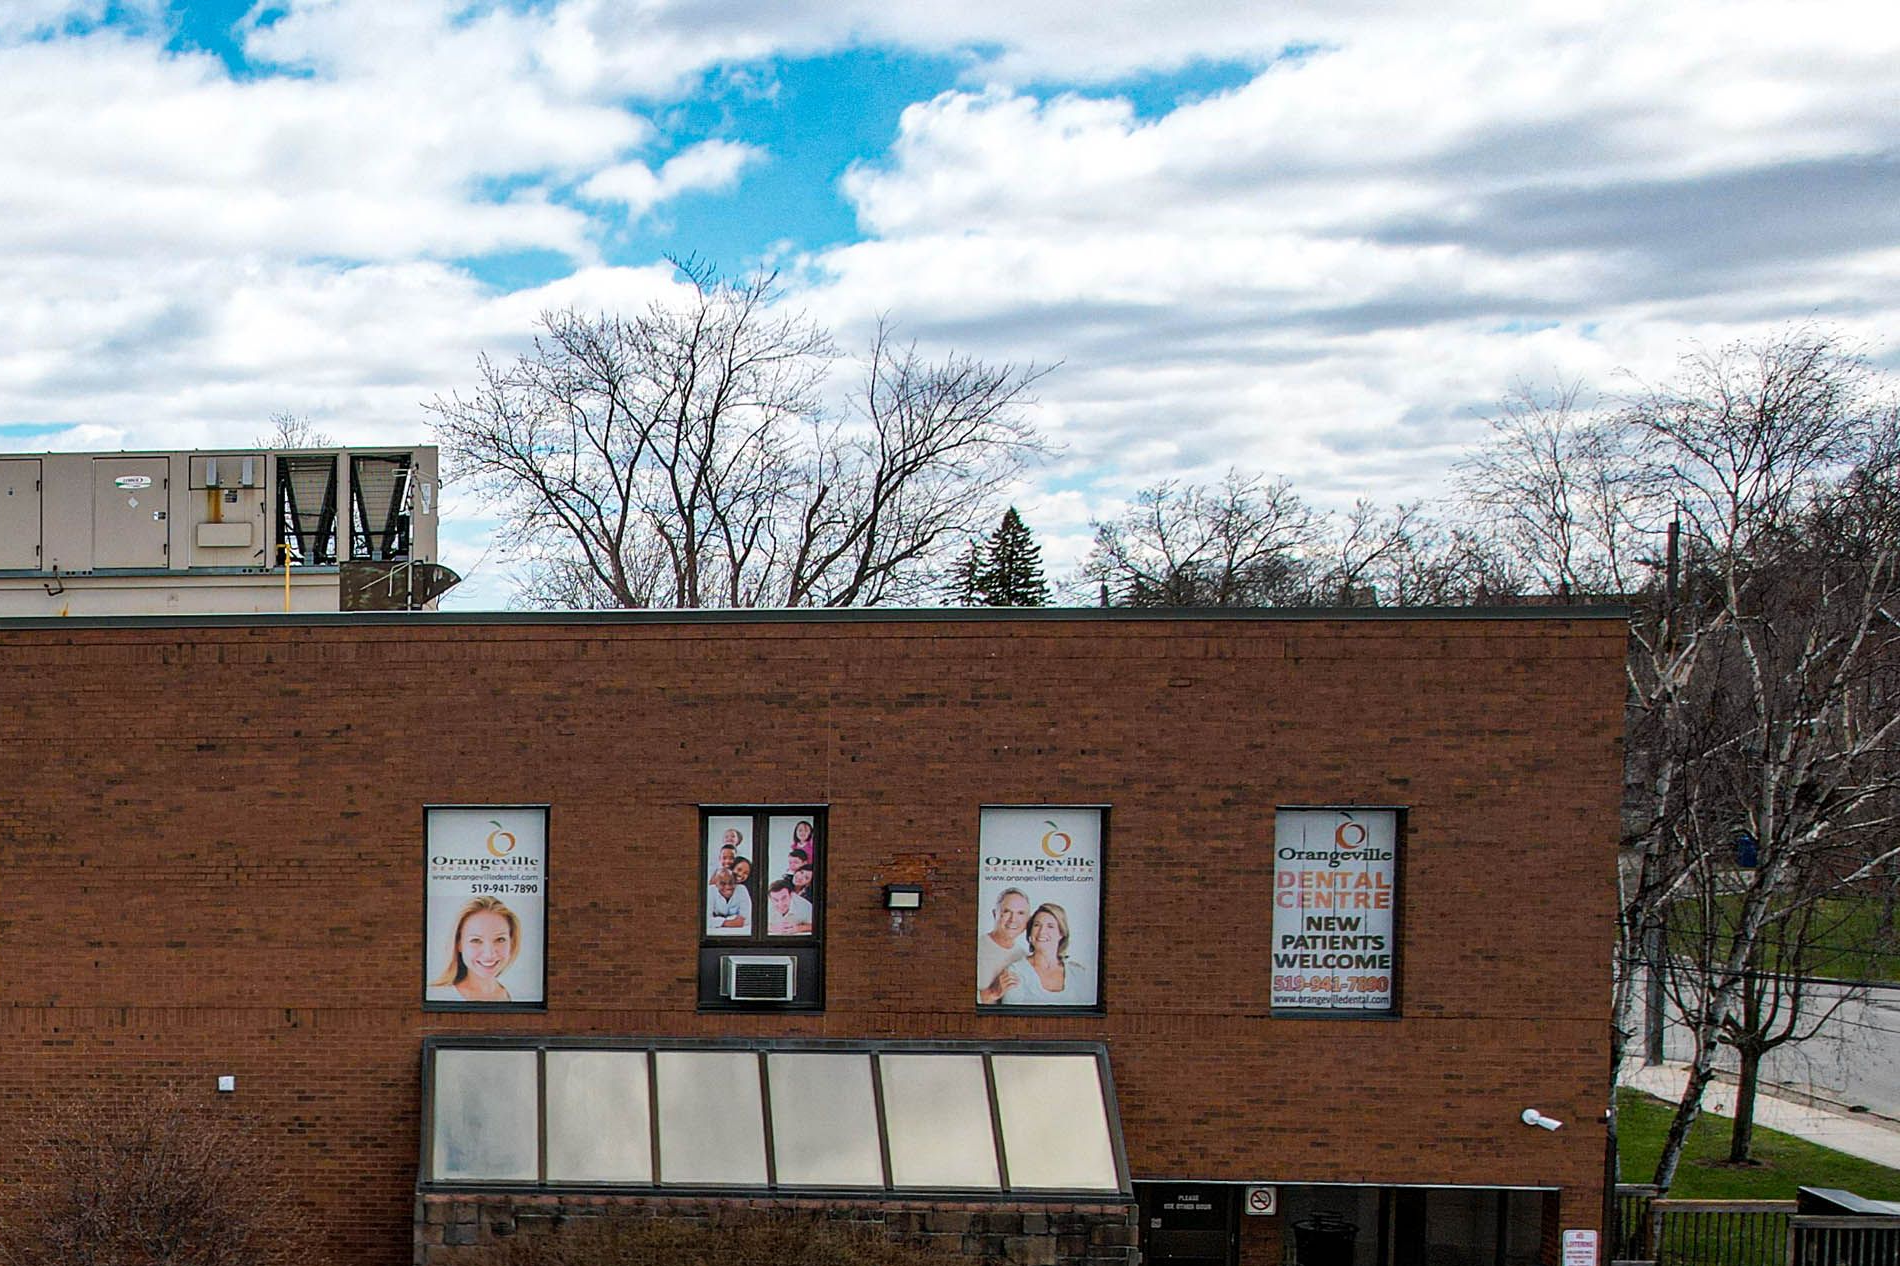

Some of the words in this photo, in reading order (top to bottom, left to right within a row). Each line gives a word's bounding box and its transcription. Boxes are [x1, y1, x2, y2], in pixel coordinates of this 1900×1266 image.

[431, 855, 539, 871] Orangeville
[985, 856, 1095, 872] Orangeville
[1278, 847, 1393, 868] Orangeville
[1276, 871, 1391, 889] DENTAL
[471, 884, 538, 893] 519-941-7890
[1276, 890, 1390, 909] CENTRE
[1306, 916, 1361, 931] NEW
[1281, 935, 1385, 950] PATIENTS
[1274, 953, 1391, 969] WELCOME
[1273, 975, 1389, 992] 519-941-7890
